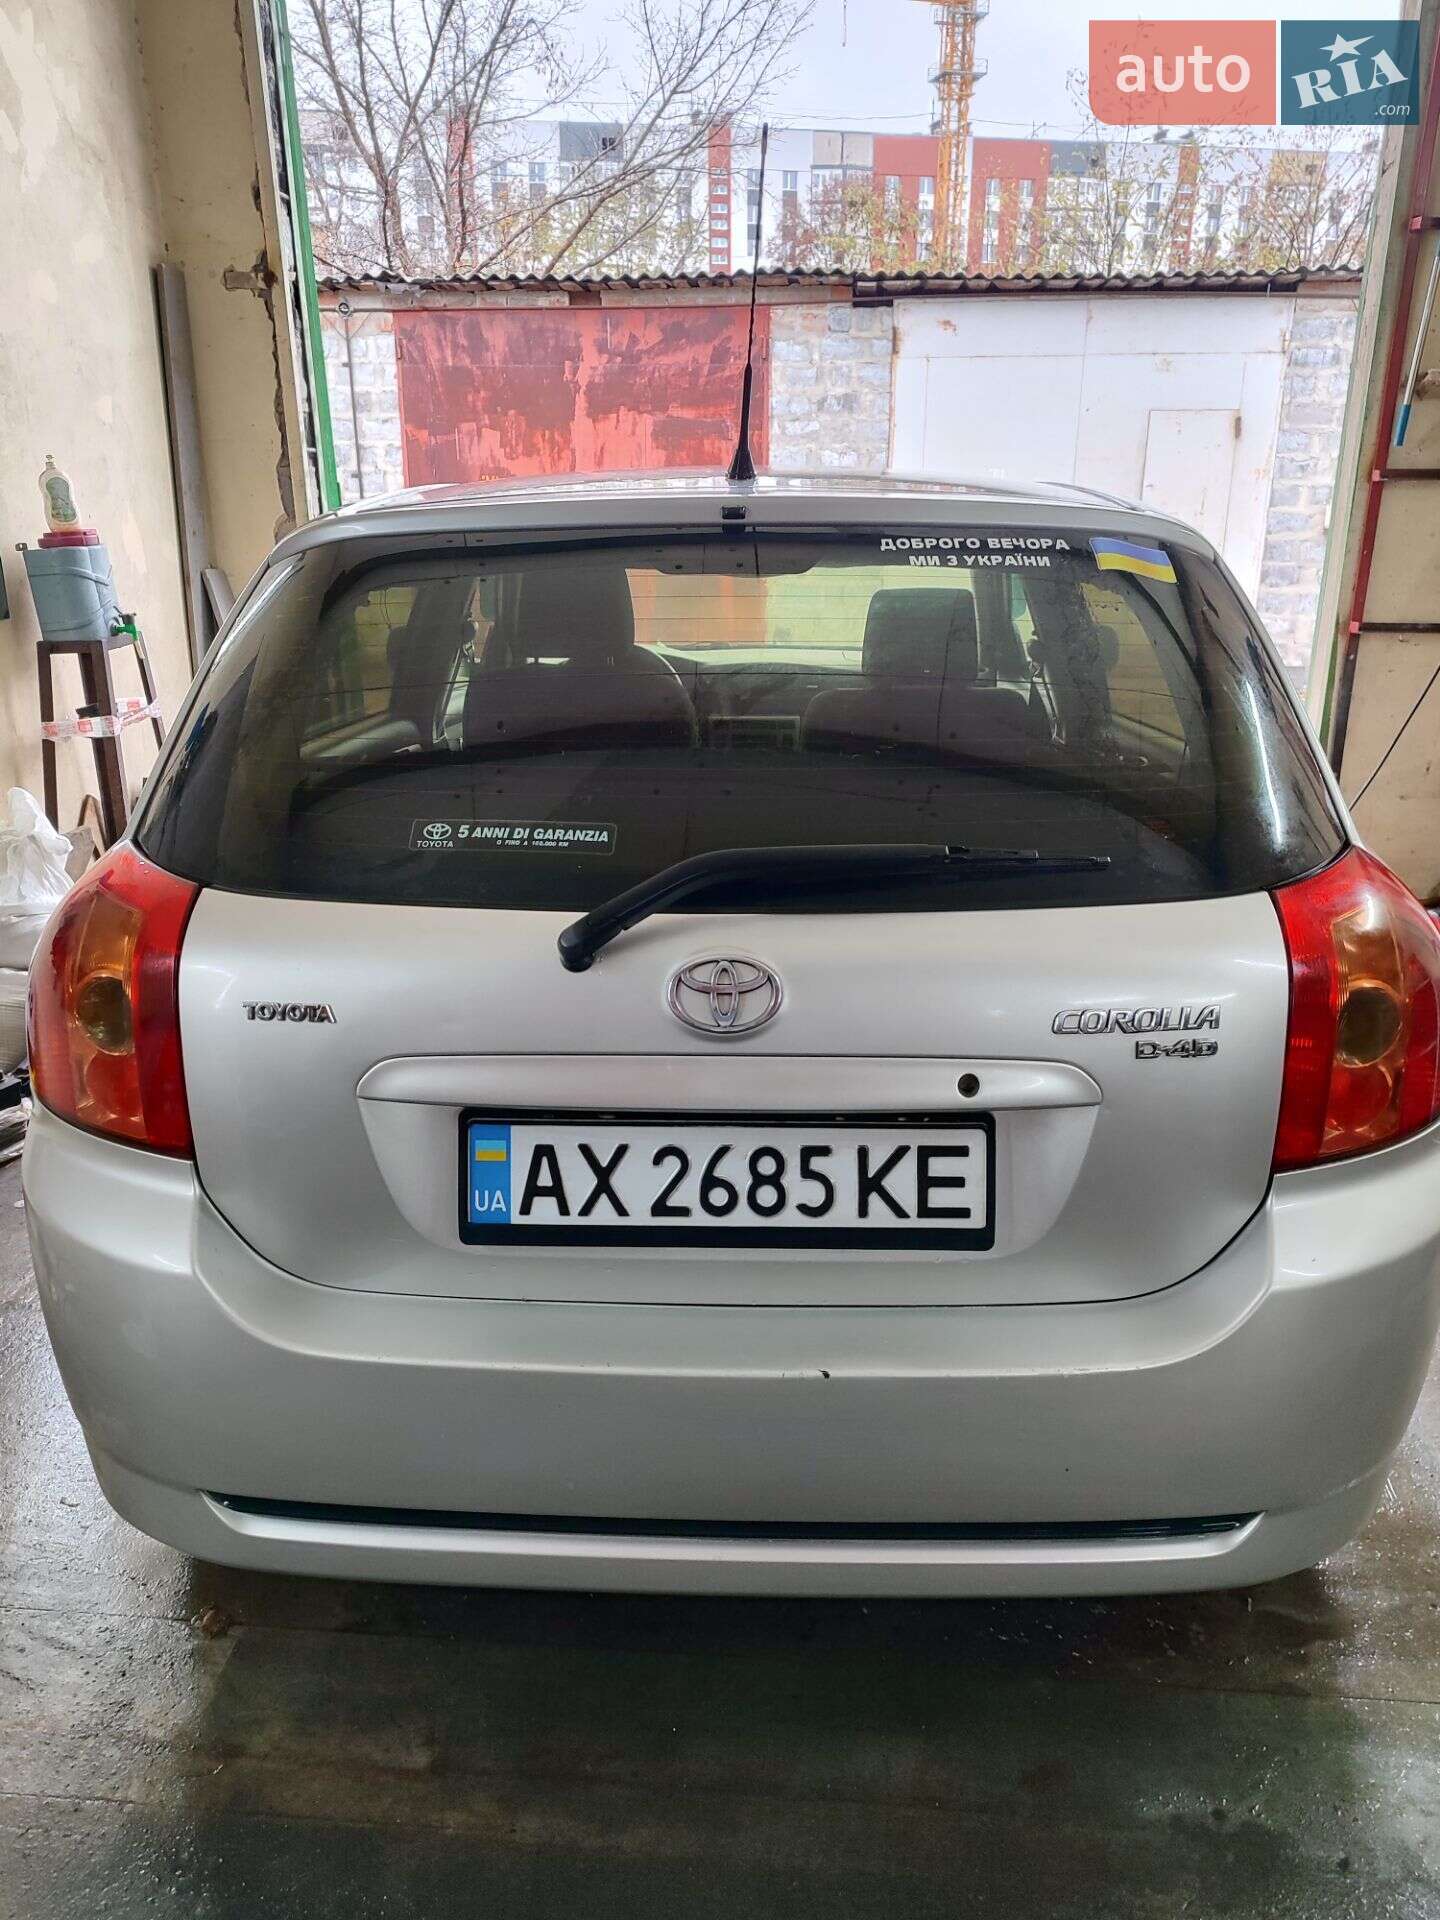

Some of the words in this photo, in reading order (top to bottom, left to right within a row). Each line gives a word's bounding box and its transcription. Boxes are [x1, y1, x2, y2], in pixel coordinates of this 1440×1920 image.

[880, 537, 978, 551] ДОБРОГО
[986, 537, 1070, 550] ВЕЧОРА
[908, 555, 940, 567] МИ
[963, 553, 1051, 567] УКРАЇНИ
[416, 840, 454, 848] TOYOTA
[457, 824, 470, 838] 5
[471, 826, 510, 838] ANNI
[513, 827, 530, 839] DI
[533, 828, 609, 842] GARANZIA
[242, 1001, 337, 1024] TOYOTA
[1052, 1004, 1221, 1035] COROLLA
[1135, 1038, 1219, 1060] D-4D
[518, 1143, 630, 1218] AX
[651, 1143, 836, 1219] 2685
[857, 1144, 972, 1219] KE
[474, 1189, 507, 1213] UA
